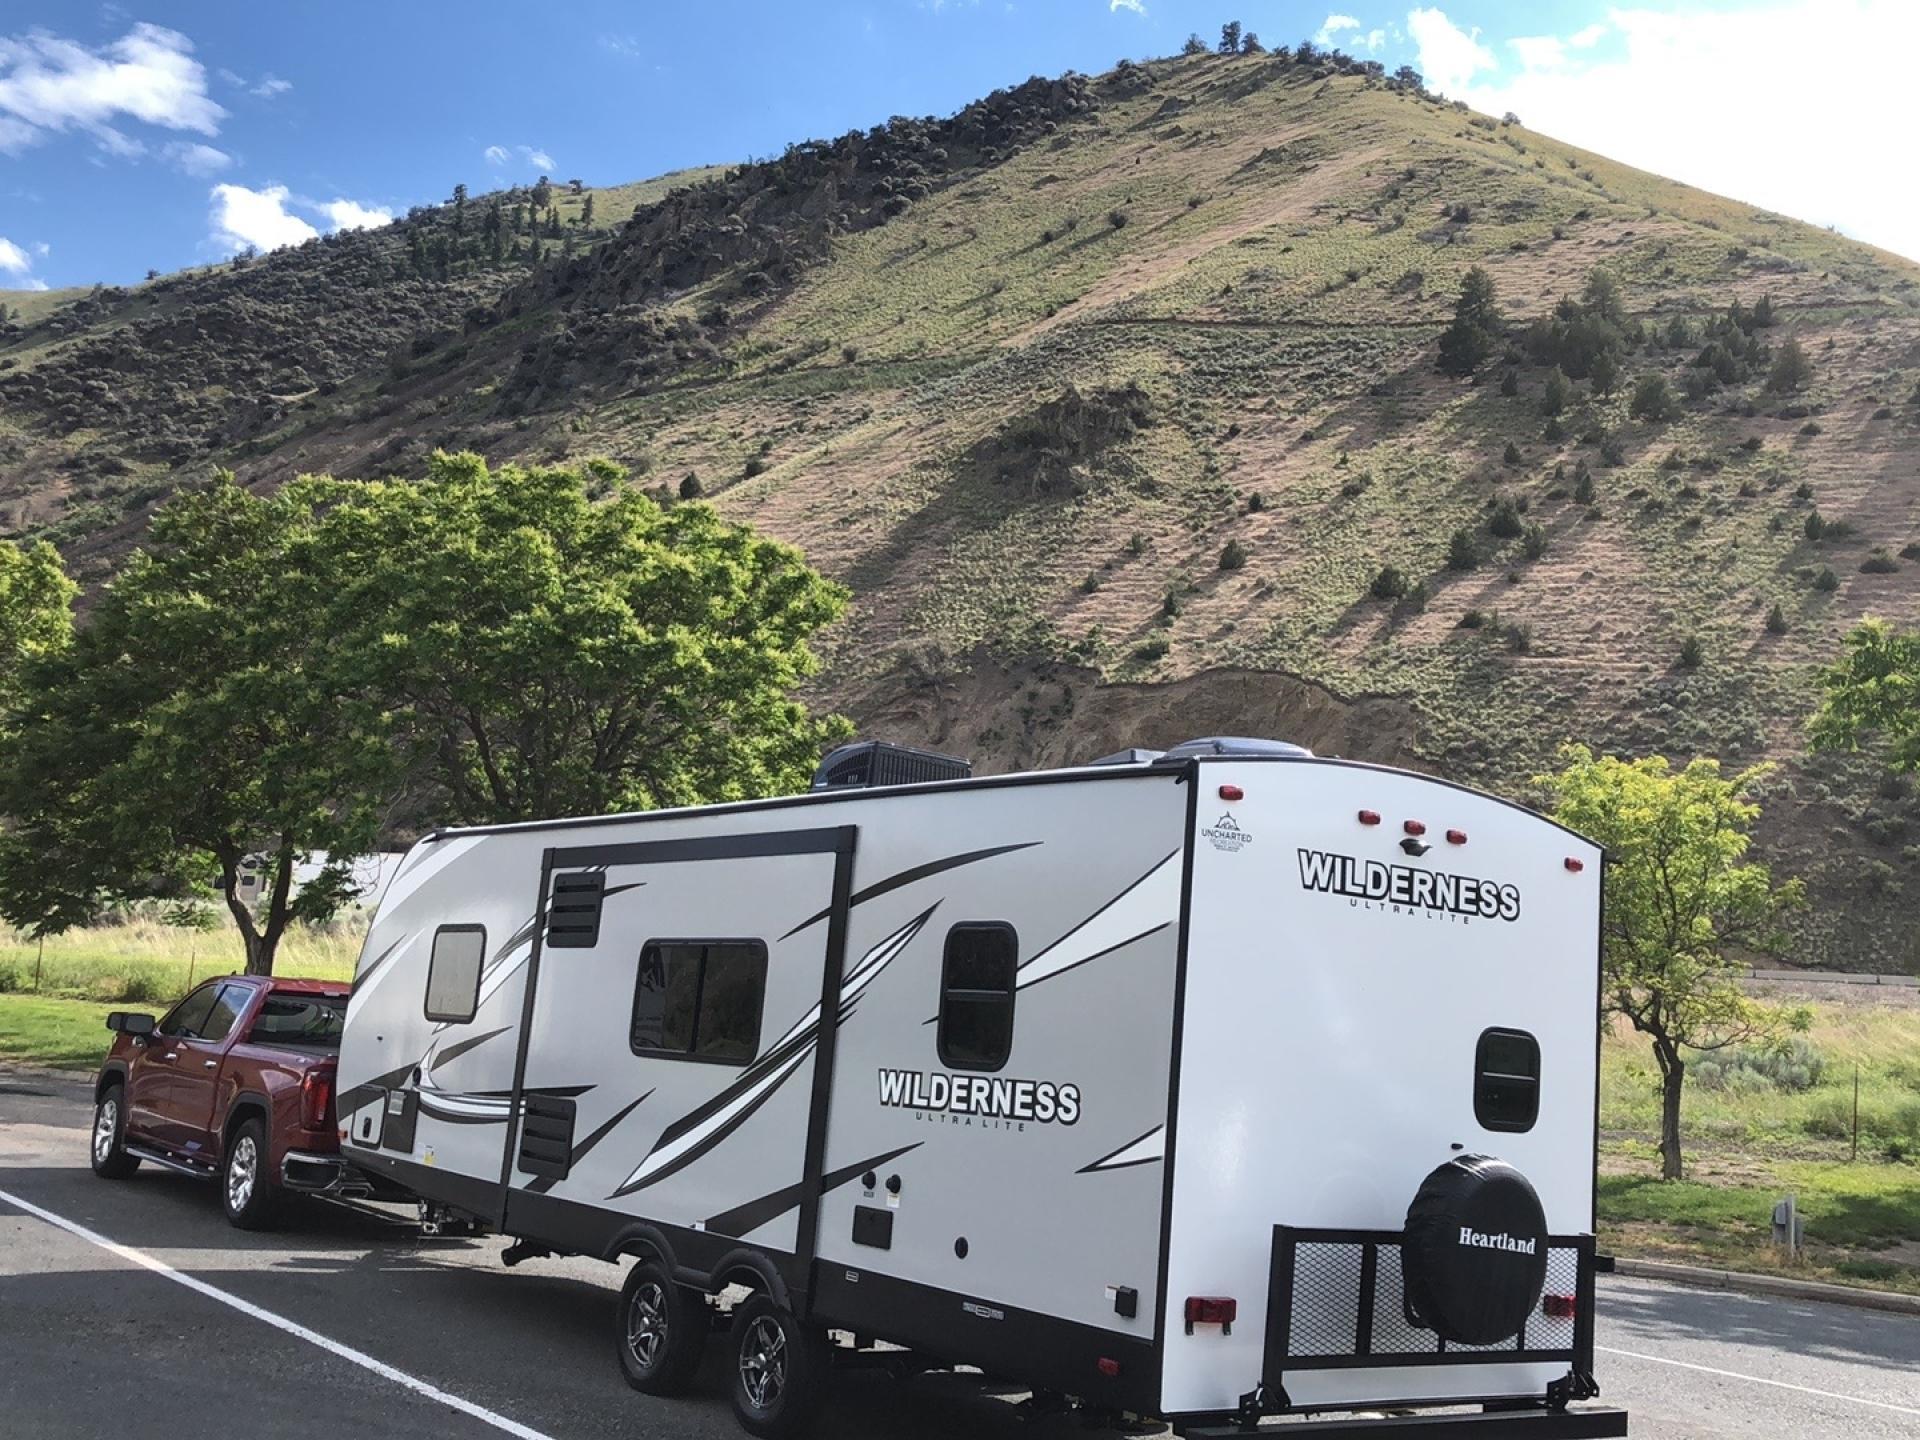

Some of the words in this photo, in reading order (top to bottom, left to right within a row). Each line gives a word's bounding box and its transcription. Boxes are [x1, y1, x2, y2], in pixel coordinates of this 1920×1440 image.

[1201, 828, 1253, 843] UNCHARTED
[1297, 848, 1520, 921] WILDERNESS
[1350, 898, 1415, 916] ULTRA
[1427, 911, 1469, 925] LITE
[879, 1068, 1081, 1126] WILDERNESS
[916, 1112, 972, 1126] ULTRA
[982, 1119, 1025, 1132] LITE
[1459, 1227, 1536, 1255] Heartland
